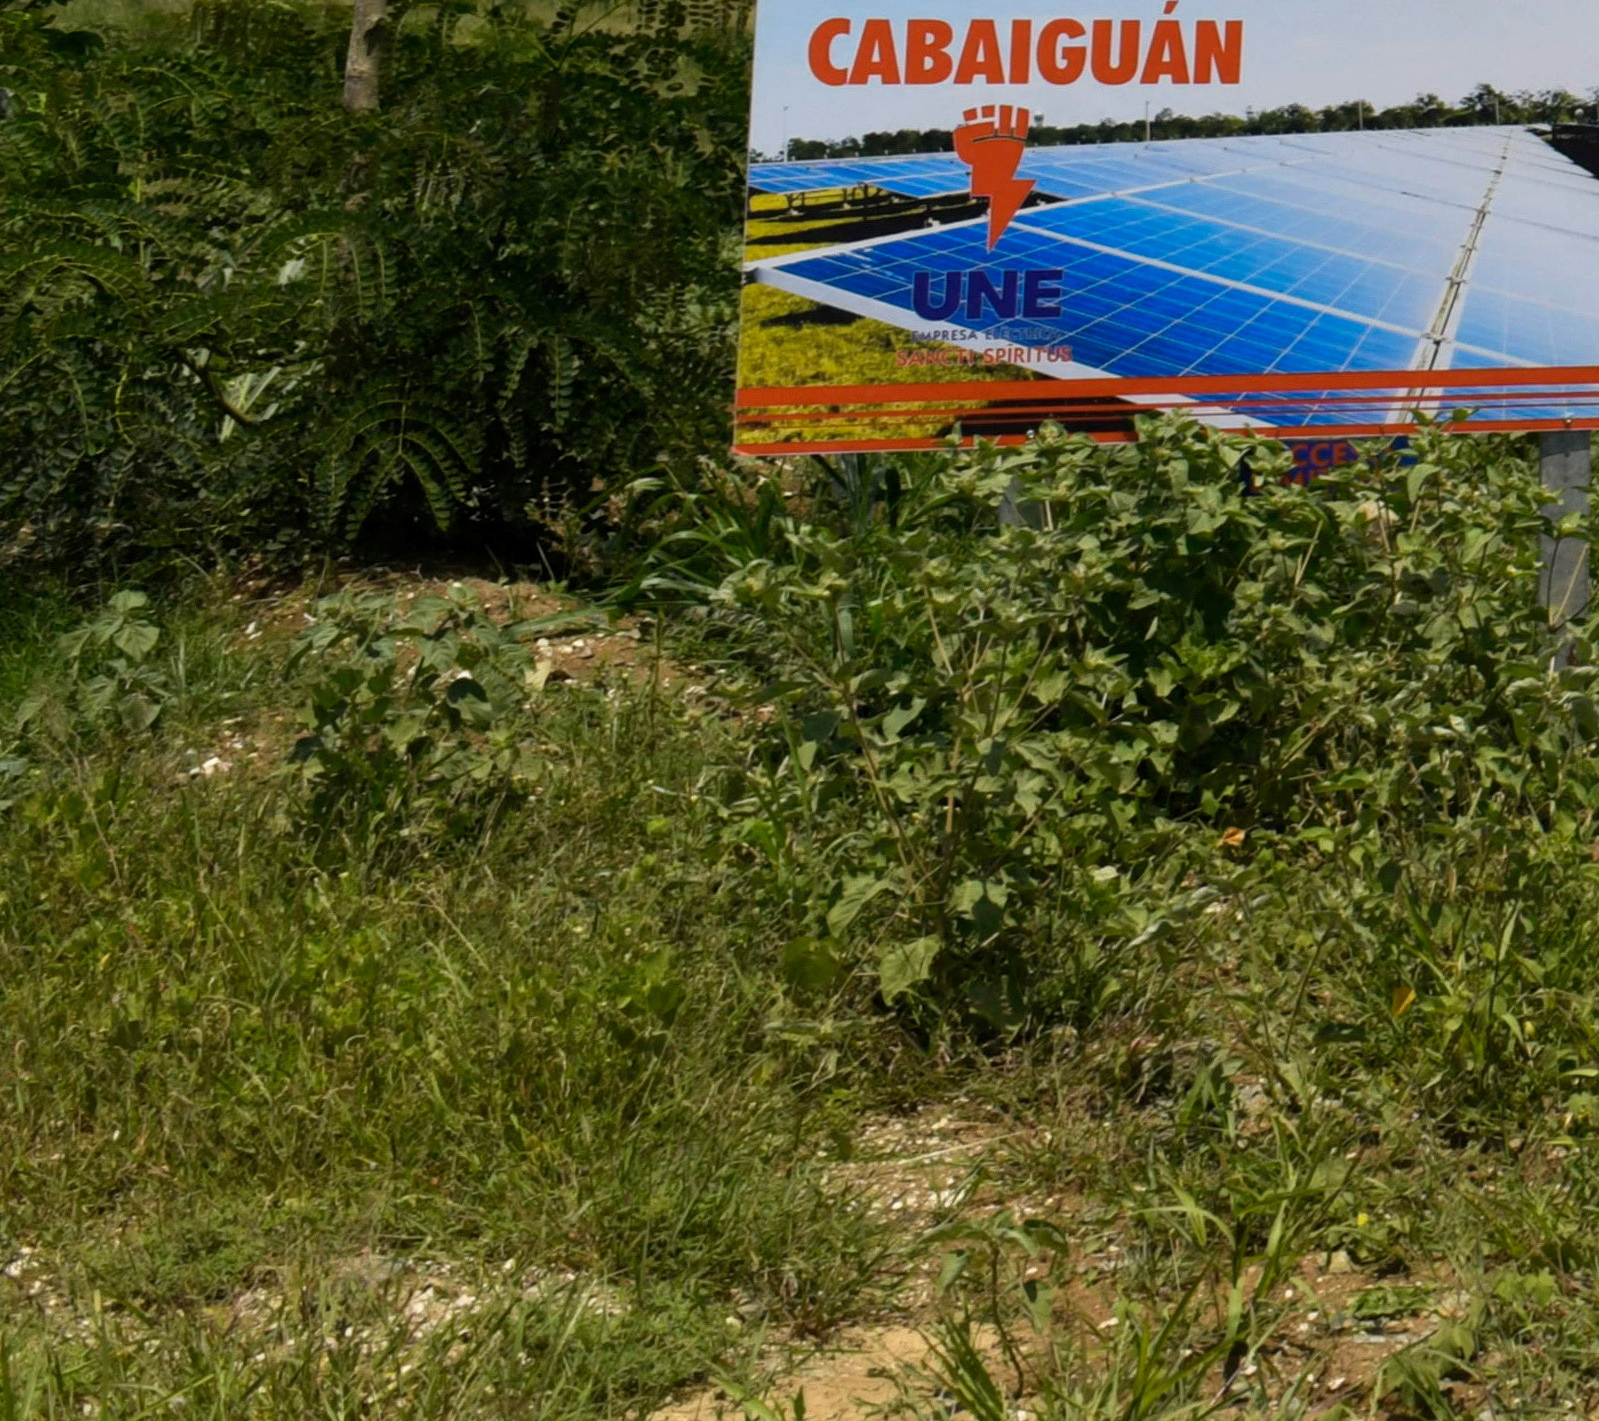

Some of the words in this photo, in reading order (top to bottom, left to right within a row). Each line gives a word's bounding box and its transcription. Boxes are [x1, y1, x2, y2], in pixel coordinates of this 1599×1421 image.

[808, 0, 1244, 87] CABAIGUÁN
[912, 269, 1064, 322] UNE
[910, 329, 978, 342] EMPRESA
[896, 348, 976, 368] SANCTI
[982, 343, 1074, 367] SPÍRITUS
